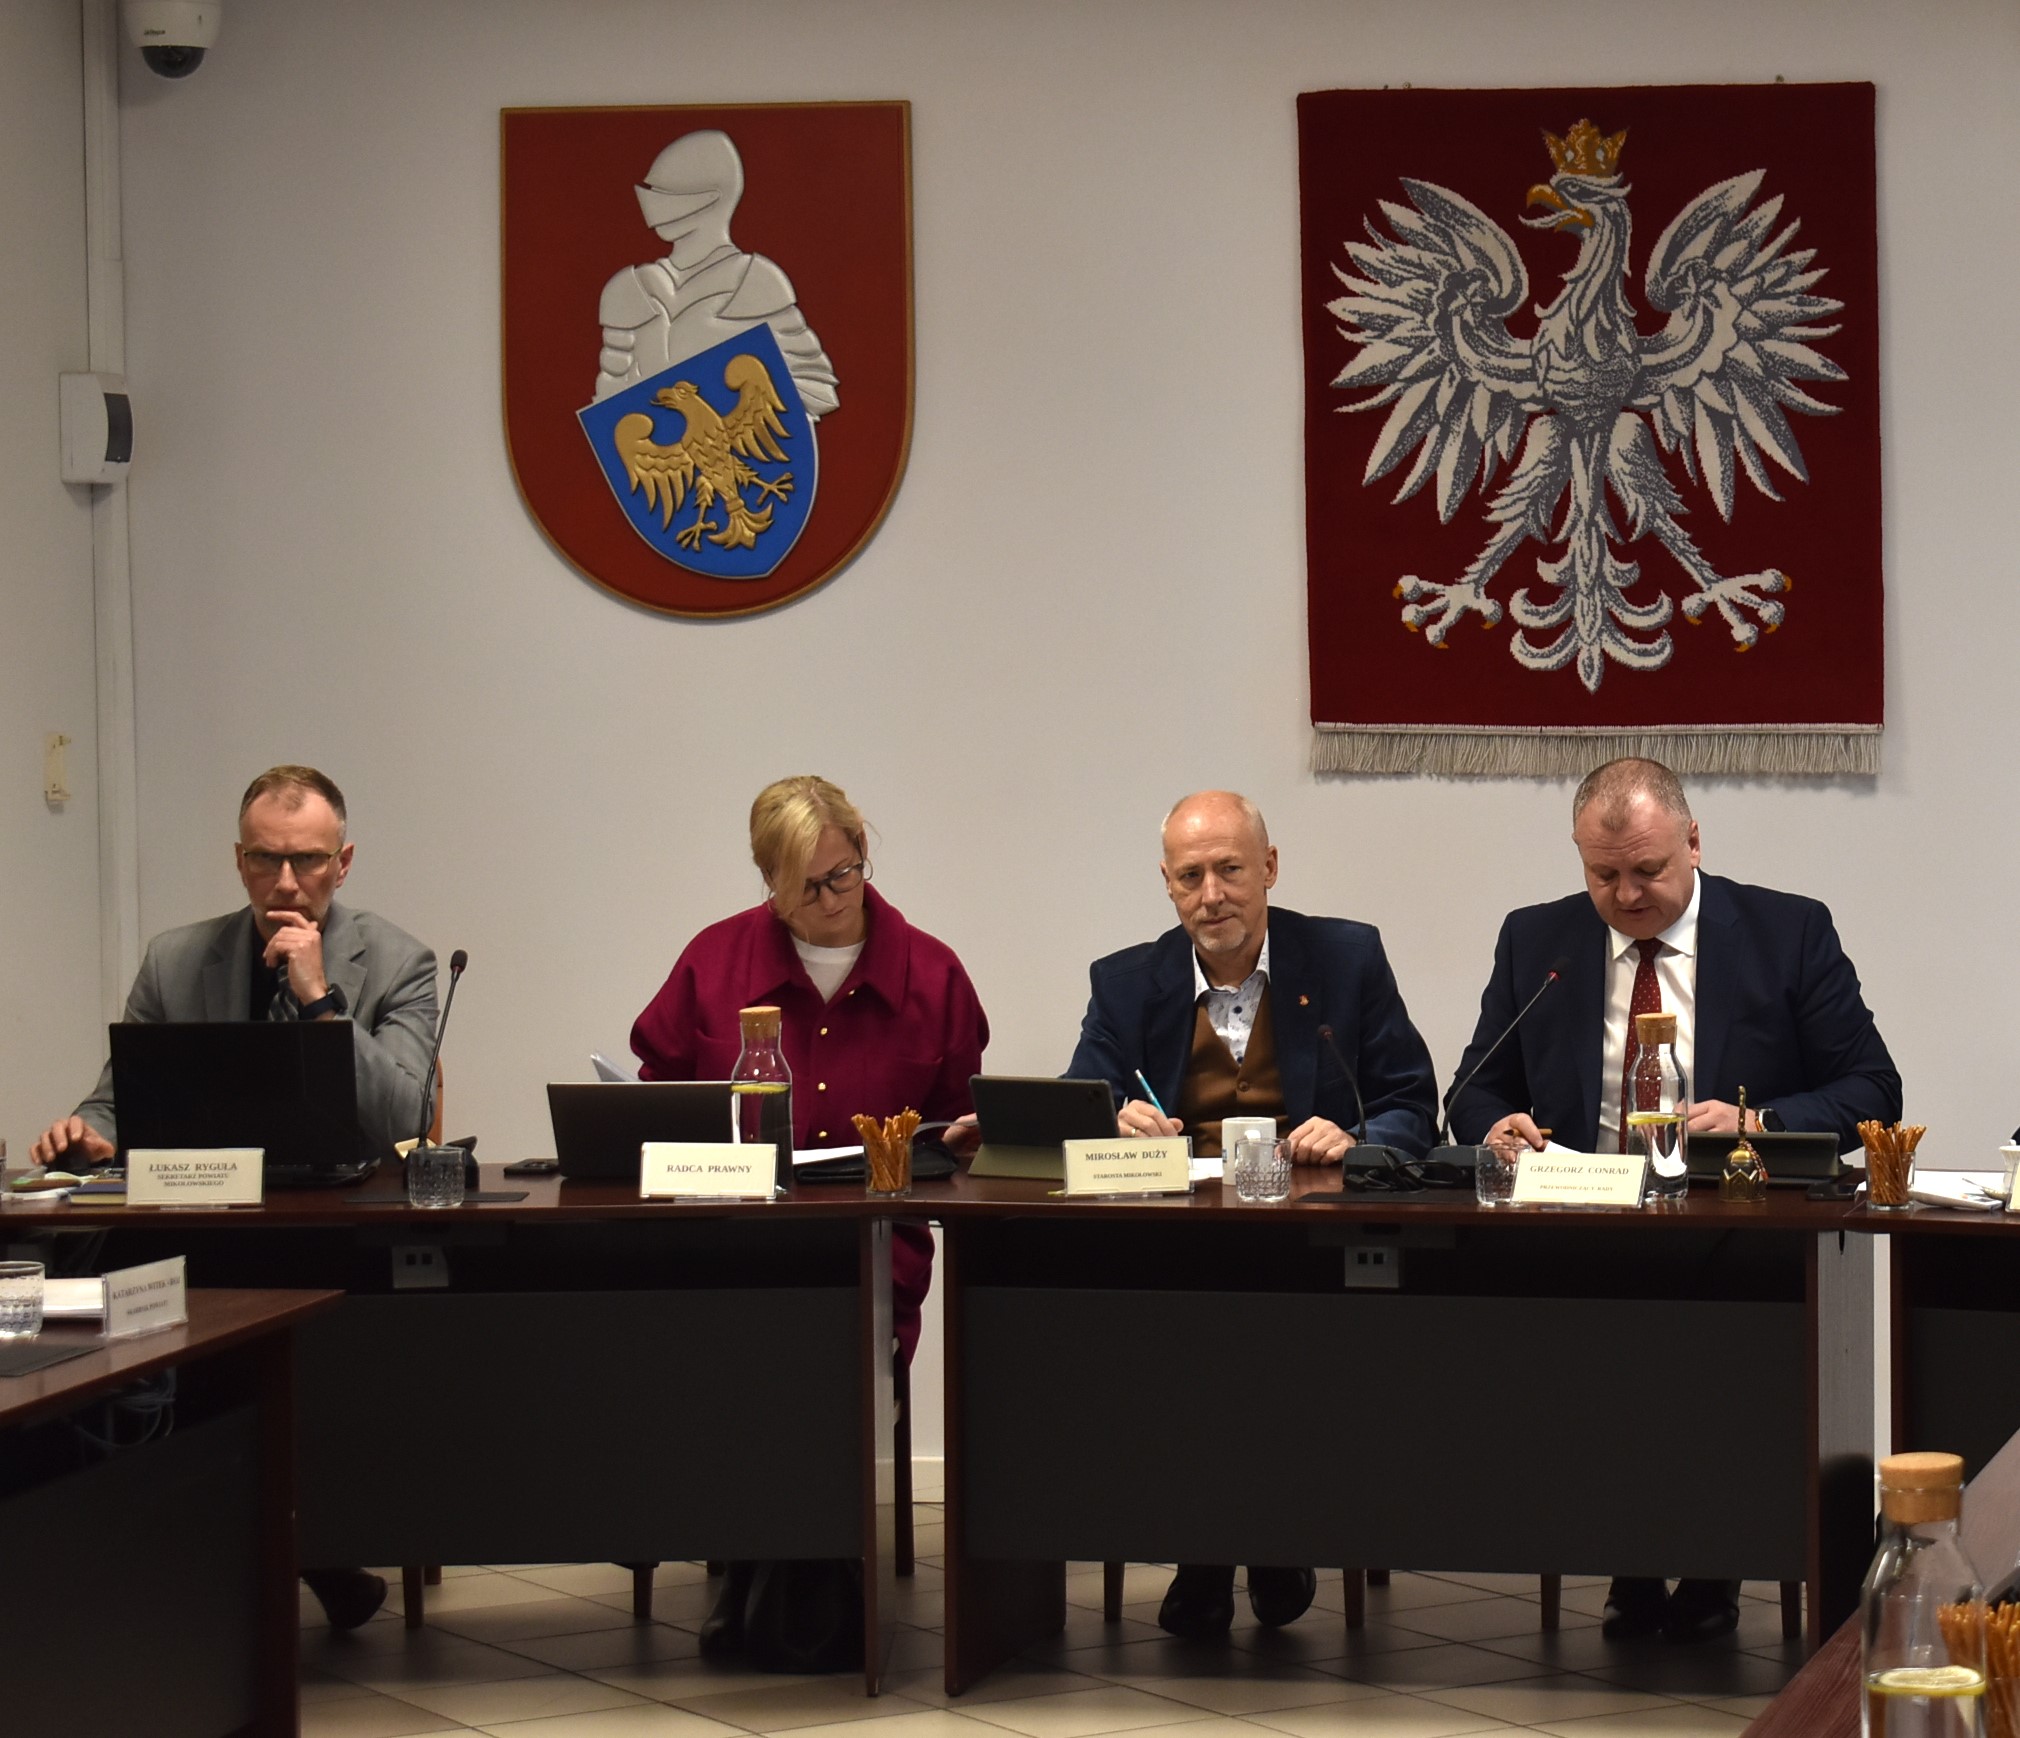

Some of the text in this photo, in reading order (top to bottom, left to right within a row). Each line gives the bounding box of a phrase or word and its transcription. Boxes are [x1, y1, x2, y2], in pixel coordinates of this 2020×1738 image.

[1085, 1149, 1168, 1161] MIROSŁAW DUŻY
[149, 1163, 191, 1173] ŁUKASZ
[666, 1164, 752, 1173] RADCA PRAWNY
[1530, 1165, 1630, 1175] GRZEGORZ CONRAD
